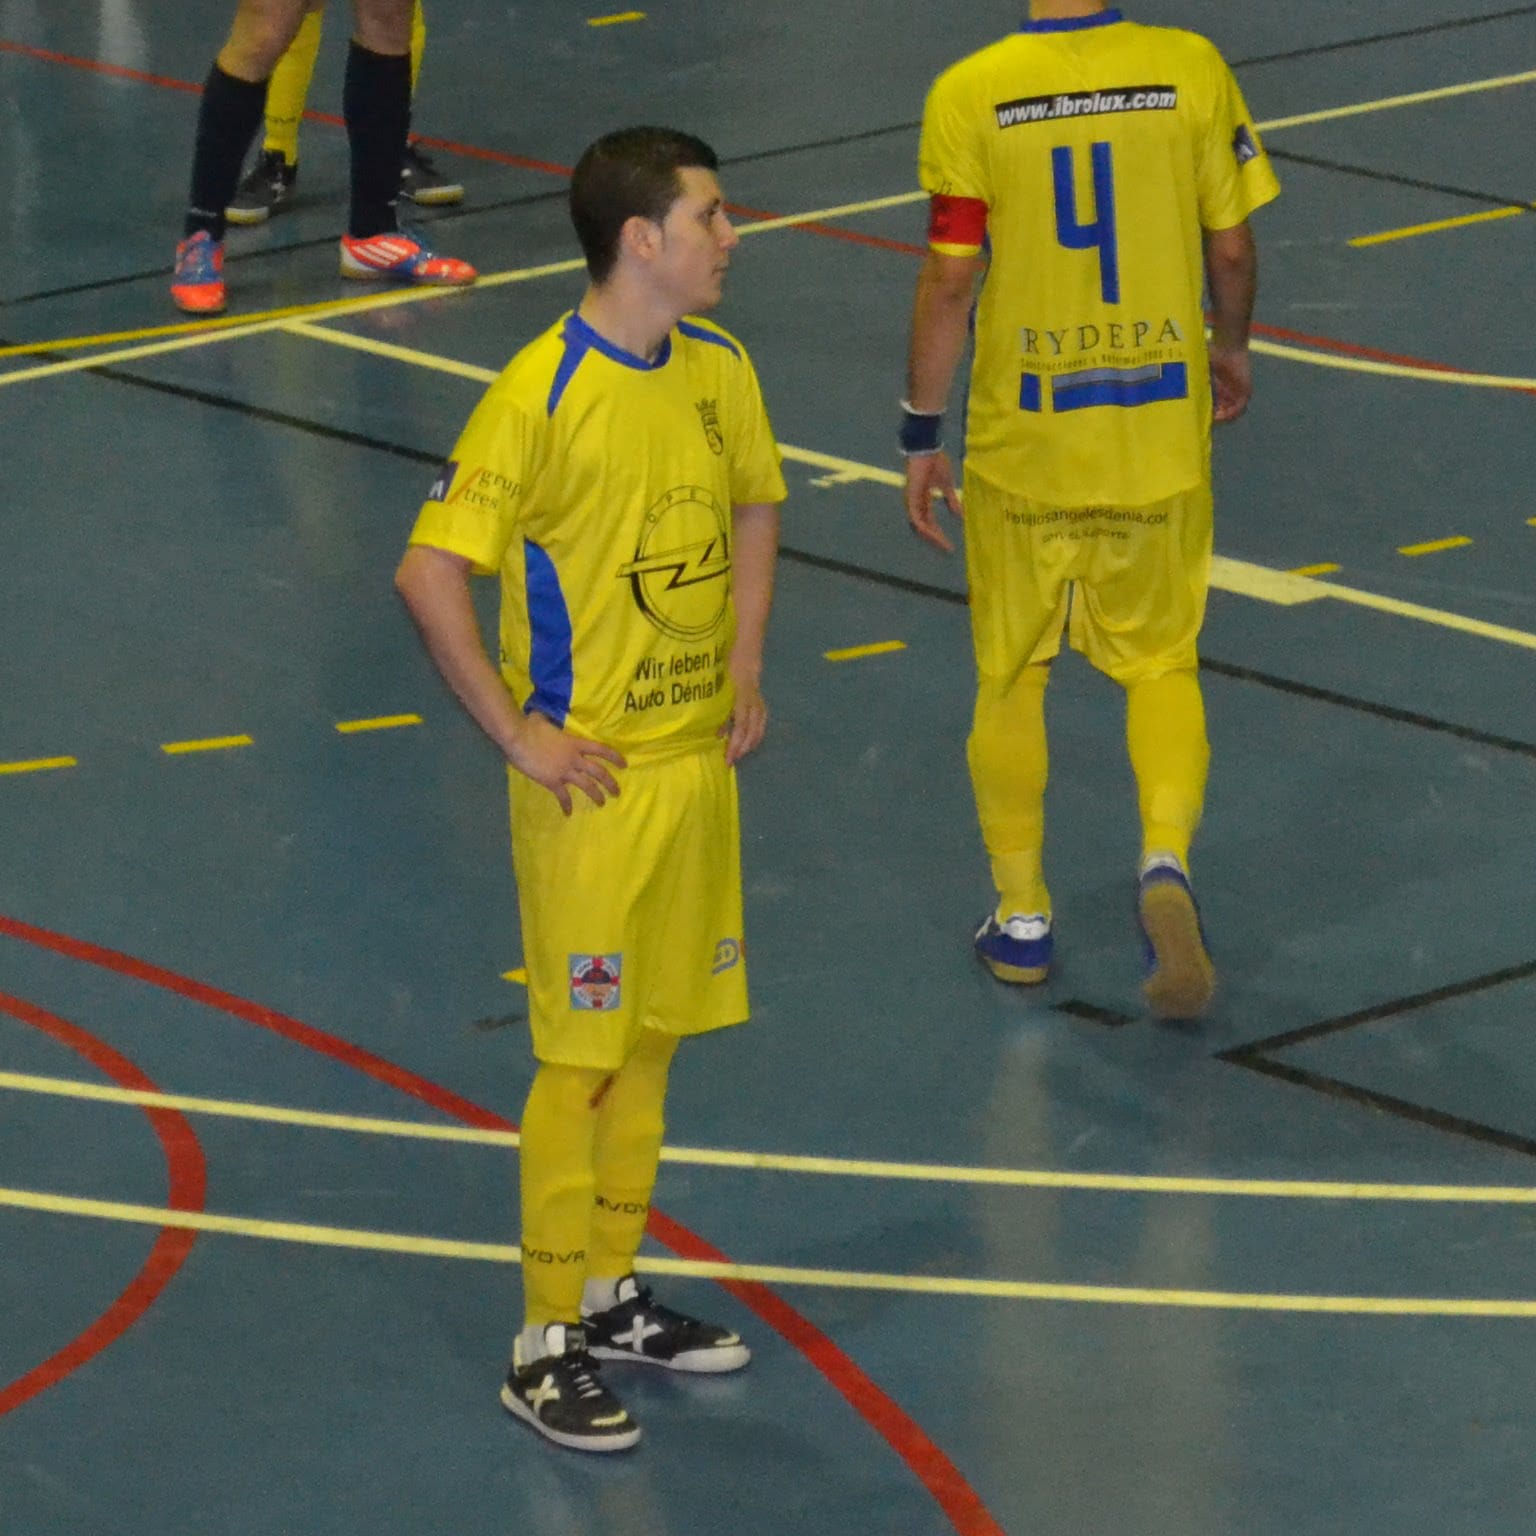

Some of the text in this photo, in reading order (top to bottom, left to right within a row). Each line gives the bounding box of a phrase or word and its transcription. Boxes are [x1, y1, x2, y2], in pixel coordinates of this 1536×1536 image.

[998, 90, 1178, 126] www.ibrolux.com
[1051, 141, 1121, 305] 4
[1020, 317, 1184, 356] RYDEPA
[635, 656, 665, 682] Wir
[669, 651, 711, 677] leben
[624, 689, 665, 713] Auto
